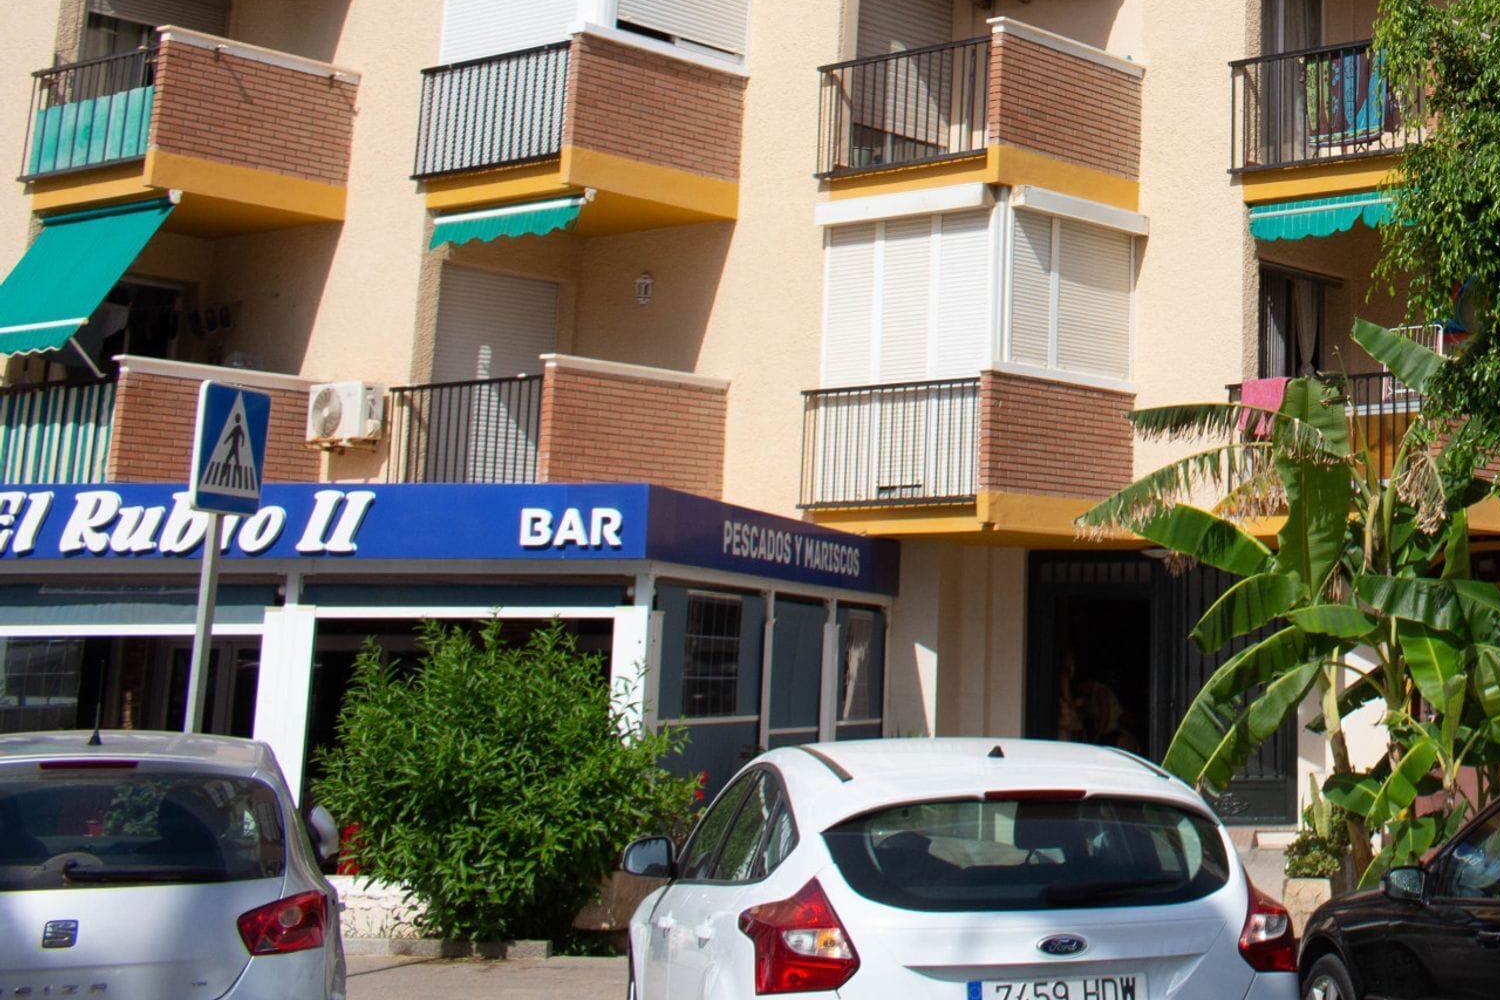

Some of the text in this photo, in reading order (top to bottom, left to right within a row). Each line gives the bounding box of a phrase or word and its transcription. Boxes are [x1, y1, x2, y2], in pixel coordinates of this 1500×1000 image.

[519, 507, 623, 549] BAR
[723, 520, 860, 577] PESCADOS Y MARISCOS
[1083, 977, 1136, 1000] HDW
